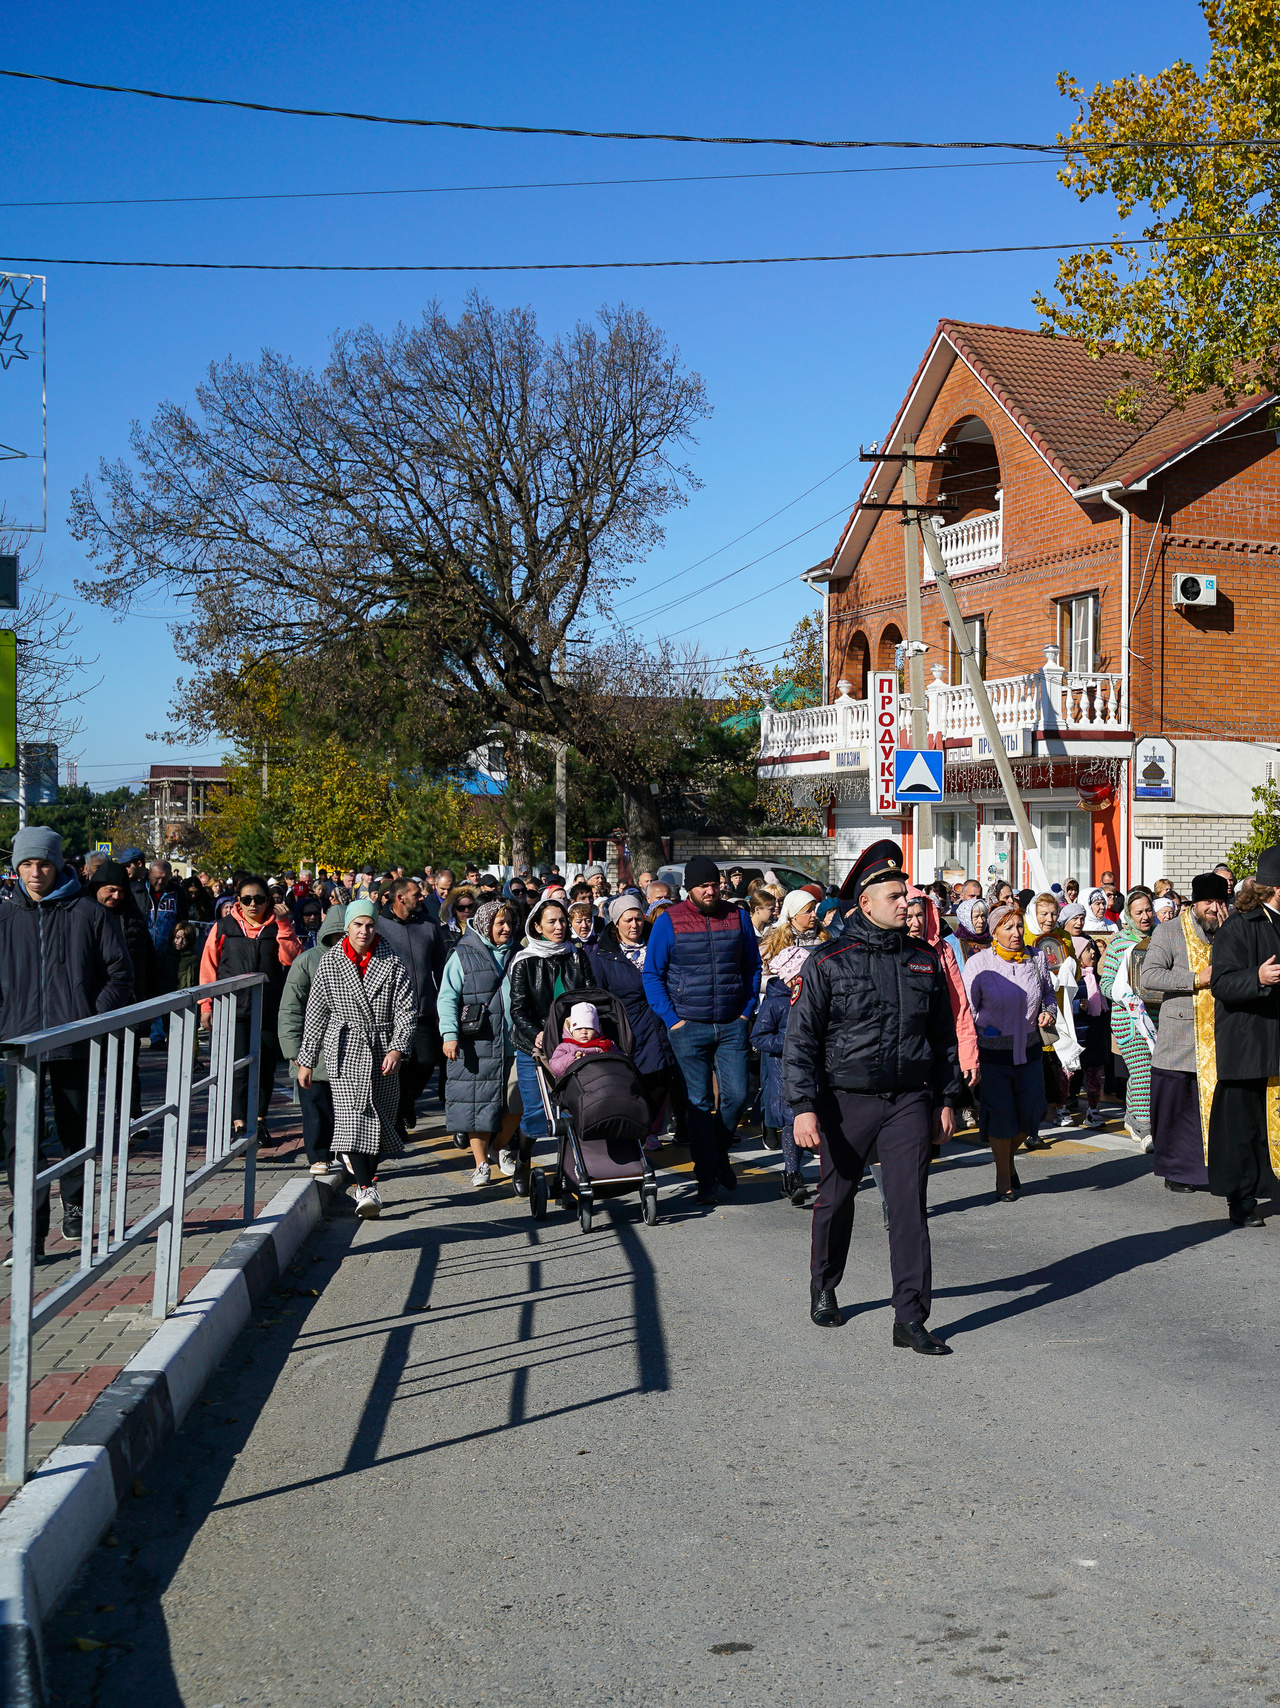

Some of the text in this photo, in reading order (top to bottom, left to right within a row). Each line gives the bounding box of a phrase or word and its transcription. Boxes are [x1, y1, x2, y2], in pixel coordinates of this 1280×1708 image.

[878, 678, 897, 810] ПРОДУКТЫ
[978, 733, 1018, 755] ПРОКТЫ
[836, 751, 861, 767] МАГАЗИН
